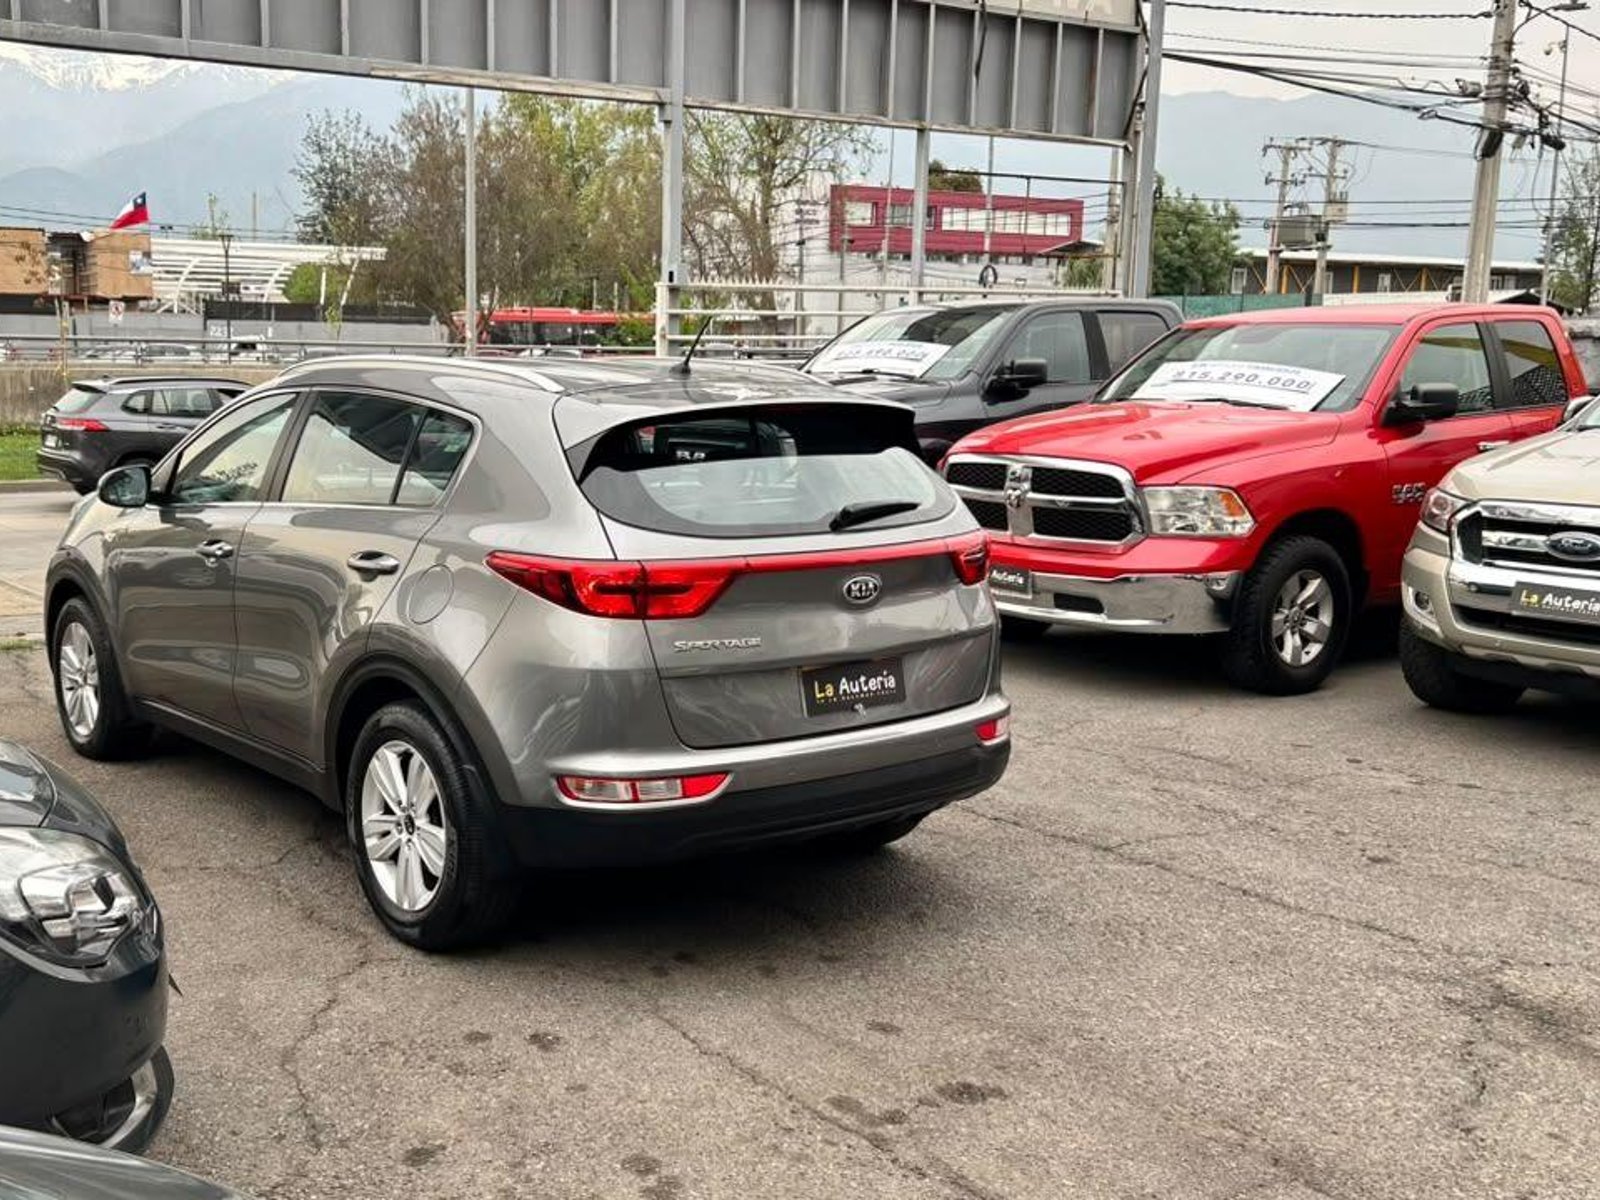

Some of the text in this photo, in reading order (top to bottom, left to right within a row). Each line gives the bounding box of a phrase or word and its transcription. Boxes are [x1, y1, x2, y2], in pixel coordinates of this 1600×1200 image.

[851, 582, 877, 598] KIA
[1521, 589, 1539, 607] La
[673, 637, 761, 653] SPORTAGE
[814, 681, 834, 699] La
